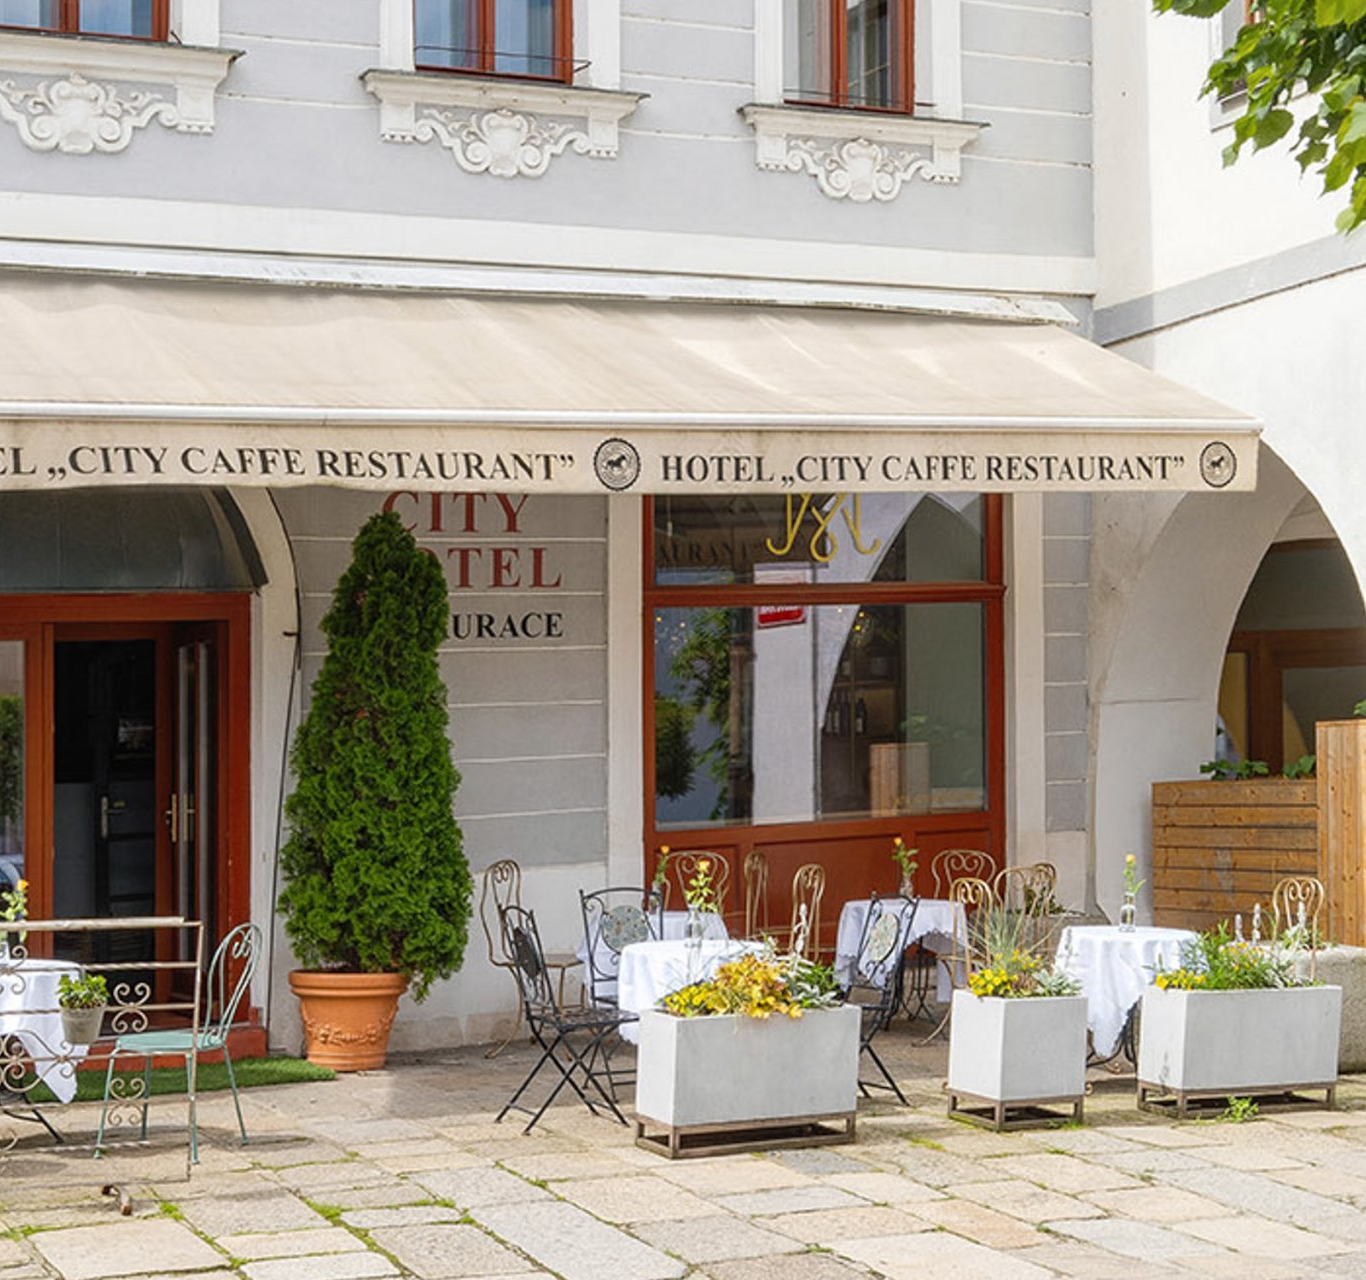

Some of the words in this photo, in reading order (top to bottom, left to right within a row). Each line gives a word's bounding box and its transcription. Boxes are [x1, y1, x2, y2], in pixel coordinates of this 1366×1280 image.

[180, 447, 306, 476] CAFFE
[661, 455, 775, 482] HOTEL
[881, 455, 977, 481] CAFFE
[381, 490, 529, 534] CITY
[416, 547, 562, 589] TEL
[444, 612, 564, 639] URACE
